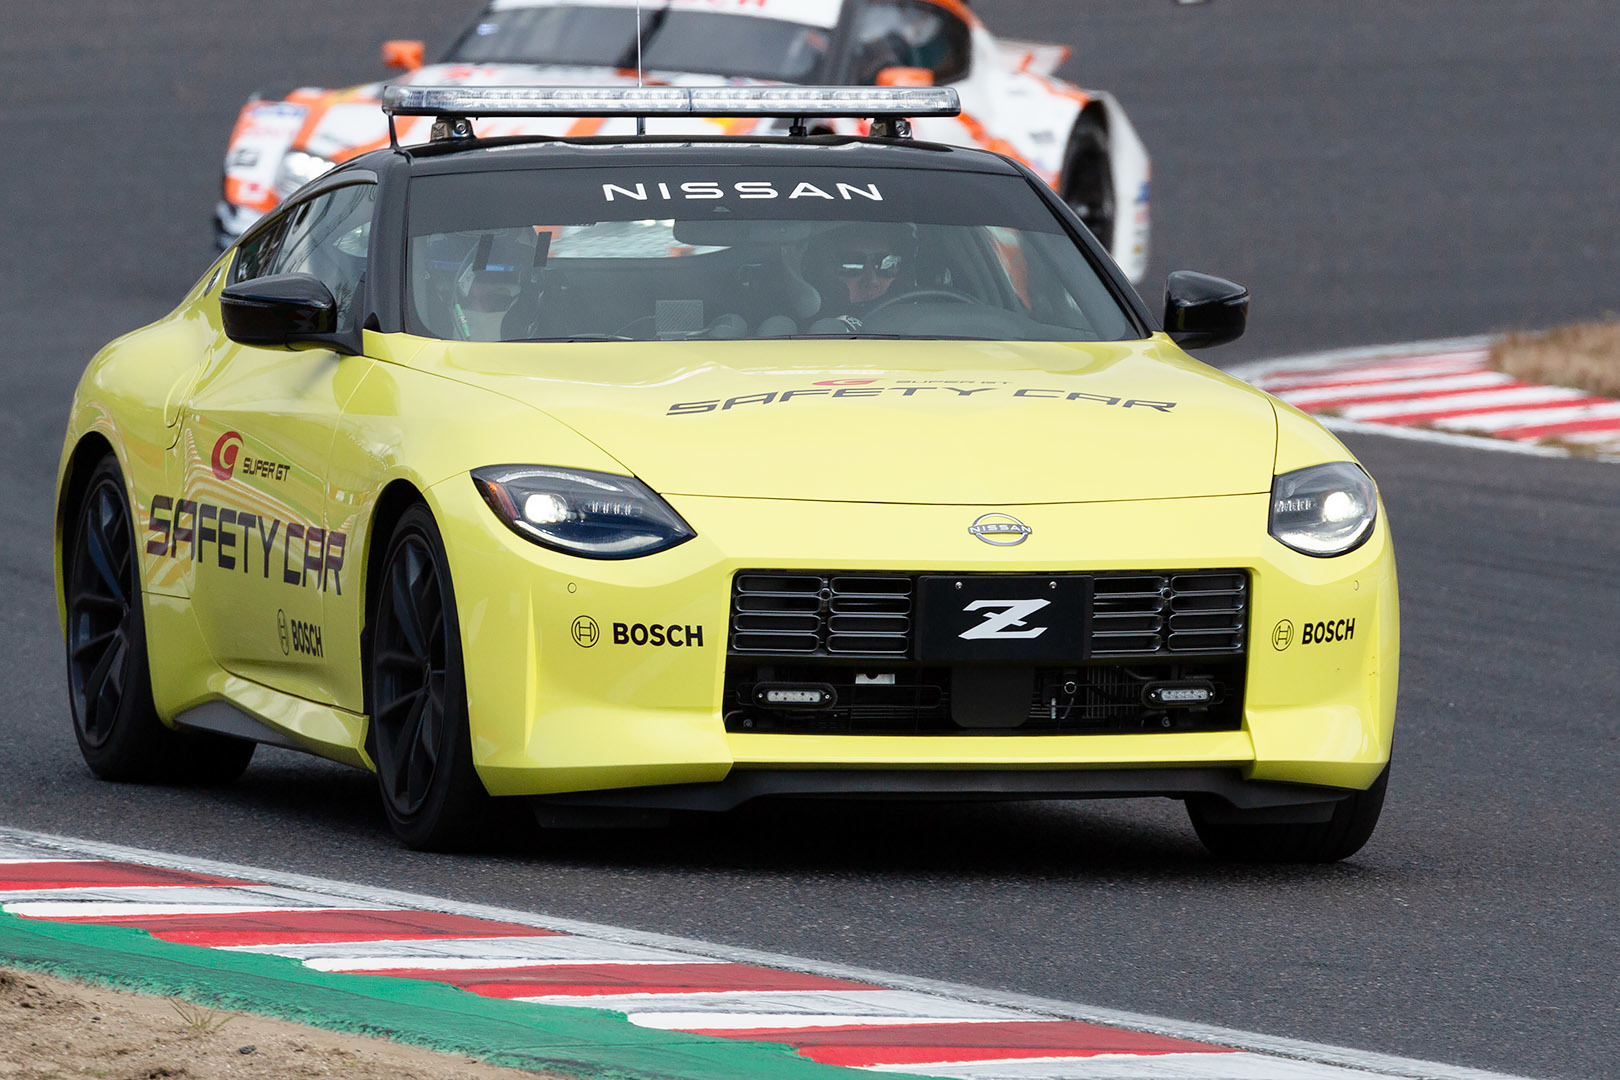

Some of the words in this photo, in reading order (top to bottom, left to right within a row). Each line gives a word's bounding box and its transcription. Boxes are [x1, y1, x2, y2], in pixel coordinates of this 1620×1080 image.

[602, 181, 883, 201] NISSAN
[666, 387, 1002, 416] SAFETY
[1012, 388, 1177, 413] CAR
[242, 457, 275, 479] SUPER
[275, 463, 290, 481] GT
[968, 524, 1032, 534] NISSAN
[147, 494, 280, 578] SAFETY
[283, 522, 347, 596] CAR
[958, 598, 1051, 640] Z
[1301, 618, 1355, 645] BOSCH
[291, 619, 324, 658] BOSCH
[613, 622, 704, 647] BOSCH
